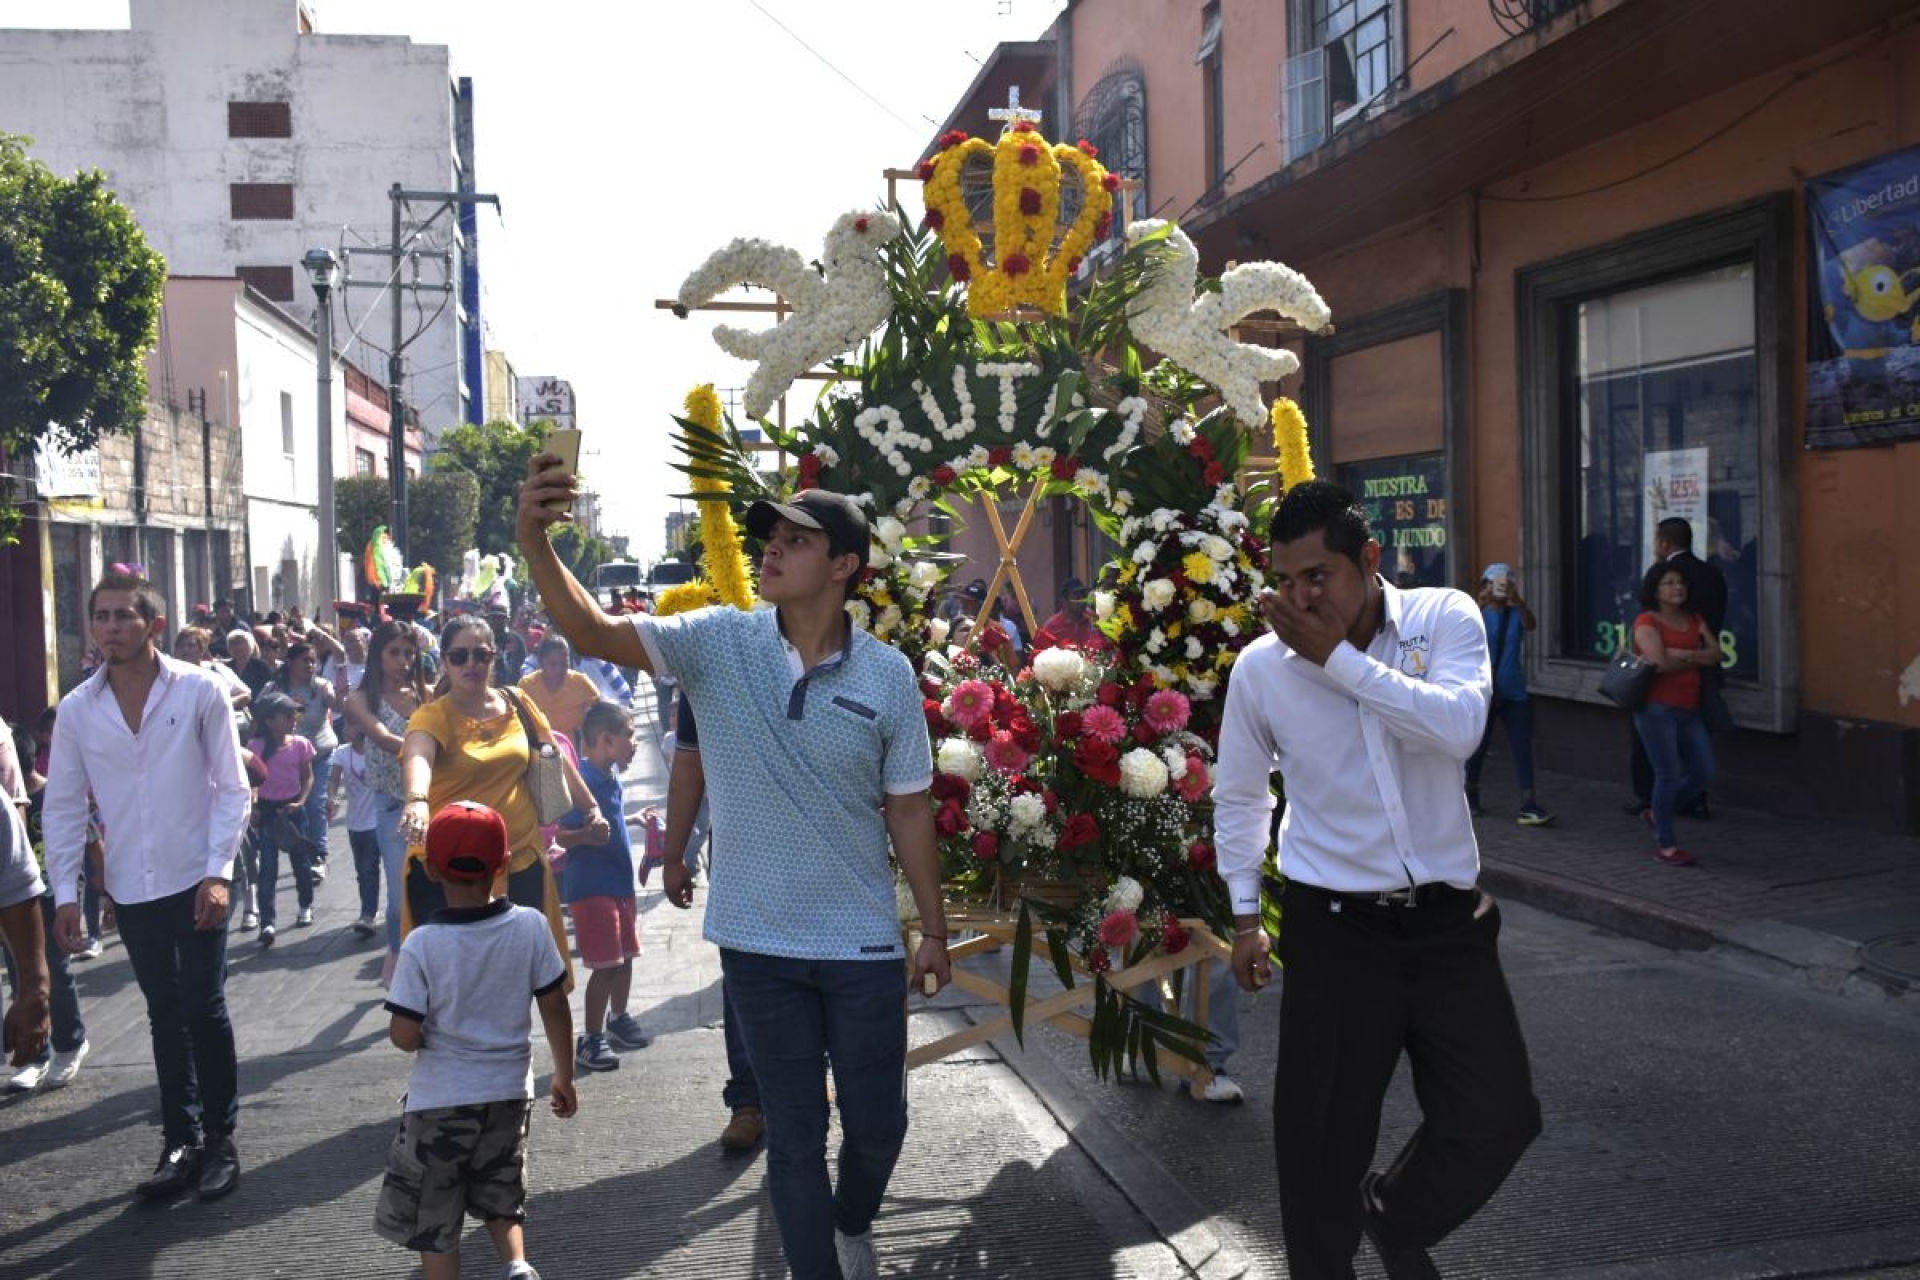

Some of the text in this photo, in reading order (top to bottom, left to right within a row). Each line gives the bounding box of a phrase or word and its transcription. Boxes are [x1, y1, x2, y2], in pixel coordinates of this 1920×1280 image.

[1840, 174, 1919, 223] Libertad
[1364, 474, 1428, 498] NUESTRA
[1395, 500, 1414, 521] ES
[1426, 498, 1445, 519] DE
[1393, 527, 1445, 547] MUNDO
[1399, 634, 1428, 649] RUTA
